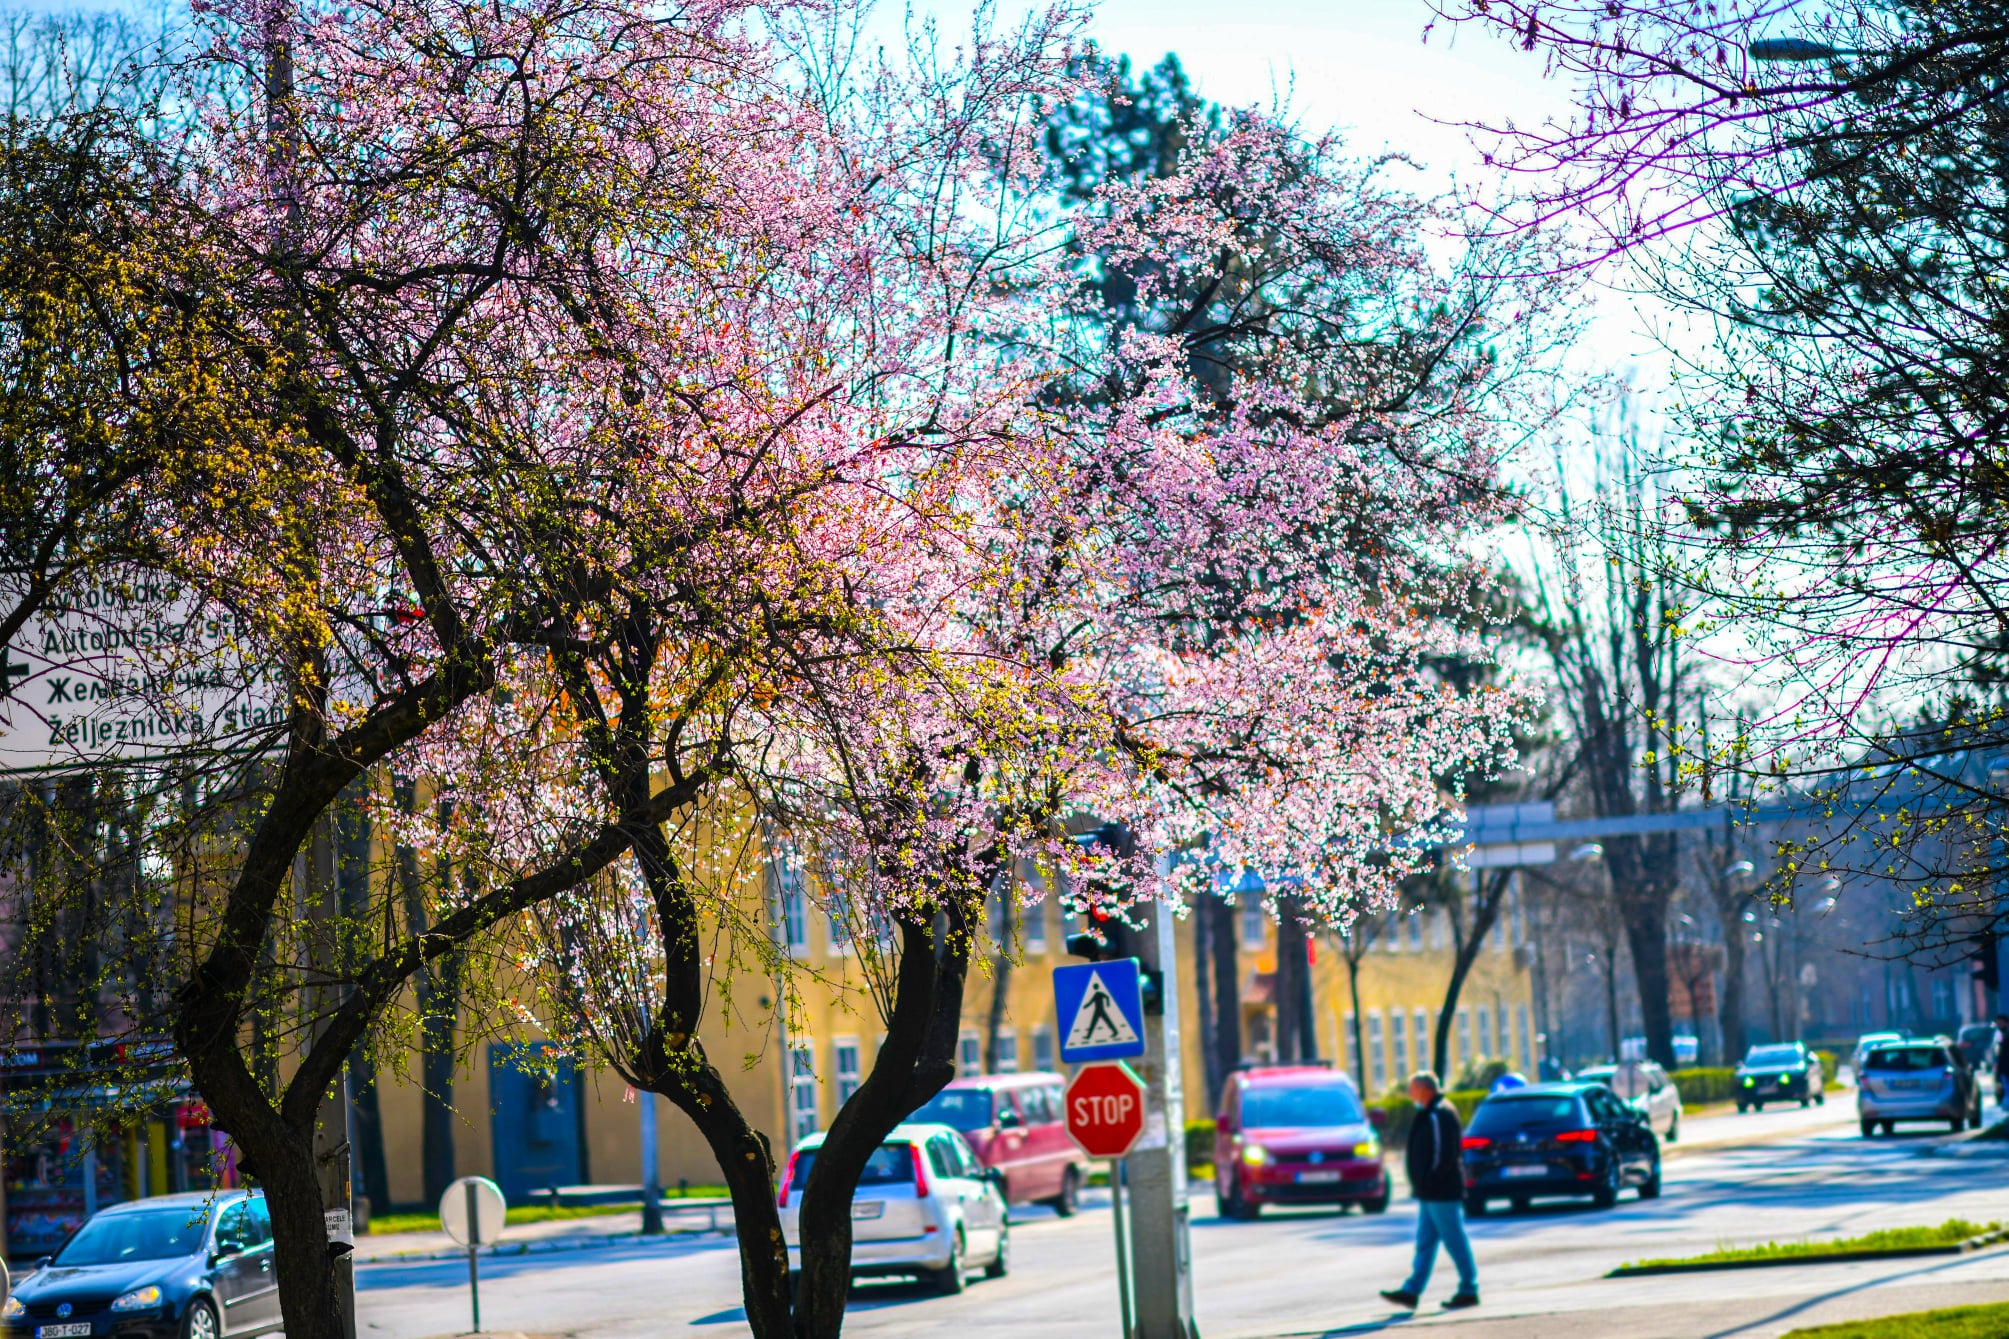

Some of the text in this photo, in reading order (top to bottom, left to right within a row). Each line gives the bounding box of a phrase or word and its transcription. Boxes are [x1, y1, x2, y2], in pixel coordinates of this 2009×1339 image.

[44, 619, 185, 656] Autobuska
[47, 709, 204, 749] Željeznička
[1074, 1094, 1133, 1127] STOP
